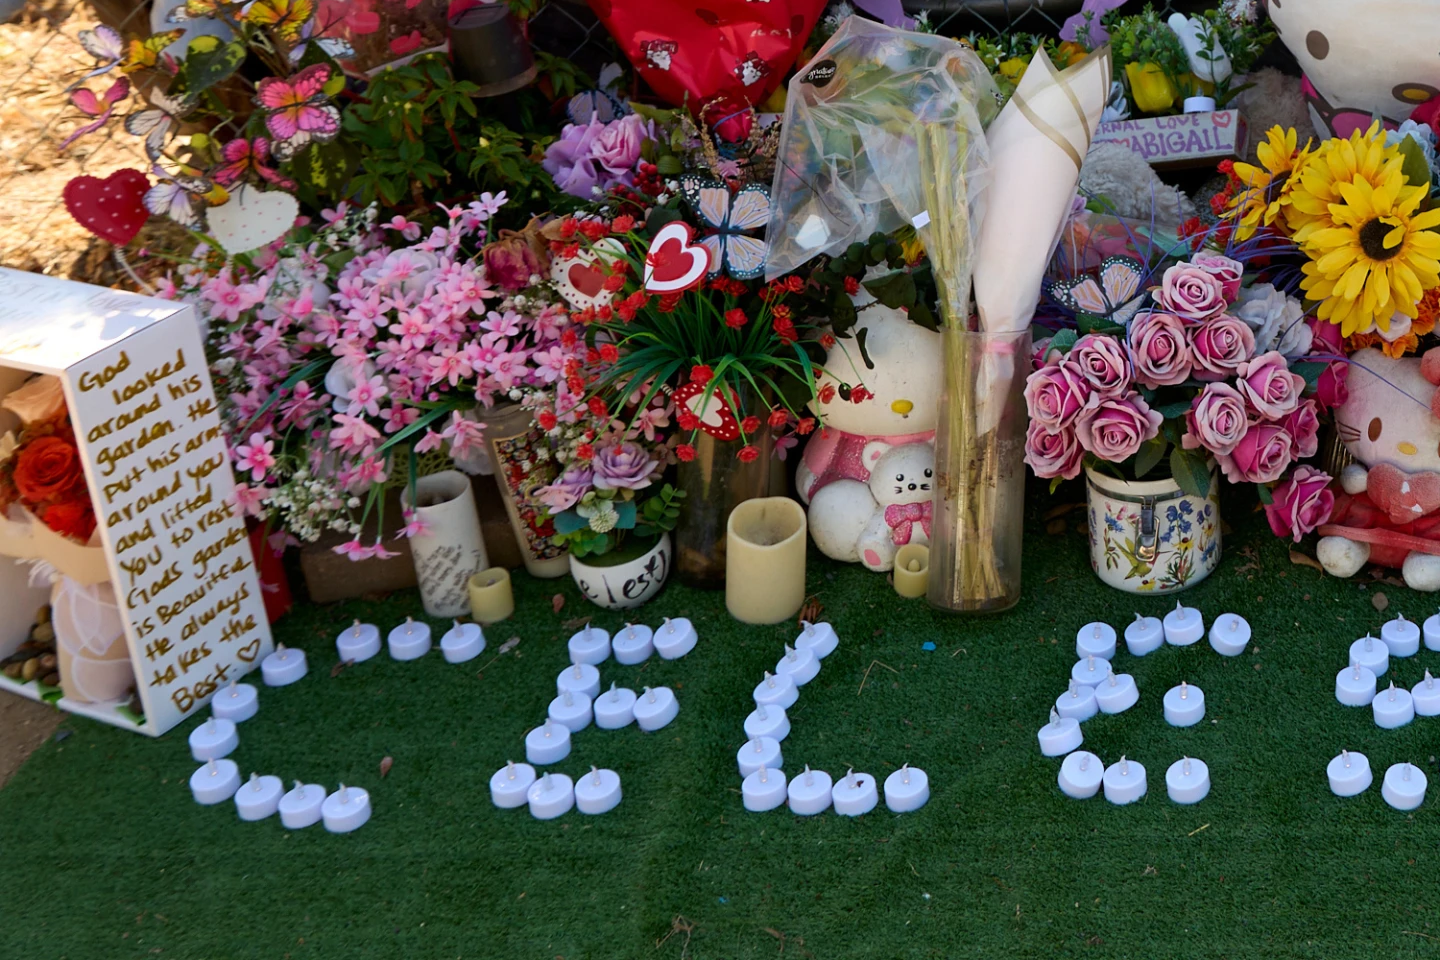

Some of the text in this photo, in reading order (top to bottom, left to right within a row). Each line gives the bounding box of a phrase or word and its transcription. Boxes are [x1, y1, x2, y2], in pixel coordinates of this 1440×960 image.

[1131, 126, 1233, 160] ABIGAIL
[1156, 113, 1200, 130] LOVE
[78, 350, 130, 392] God
[112, 348, 186, 406] looked
[87, 374, 202, 444] around his
[188, 398, 219, 422] He
[146, 442, 181, 472] his
[107, 470, 182, 528] around
[116, 483, 213, 555] and lifted
[171, 527, 194, 548] to
[196, 499, 236, 533] rest
[132, 616, 155, 639] is
[145, 581, 250, 662] He always
[149, 614, 258, 688] takes the
